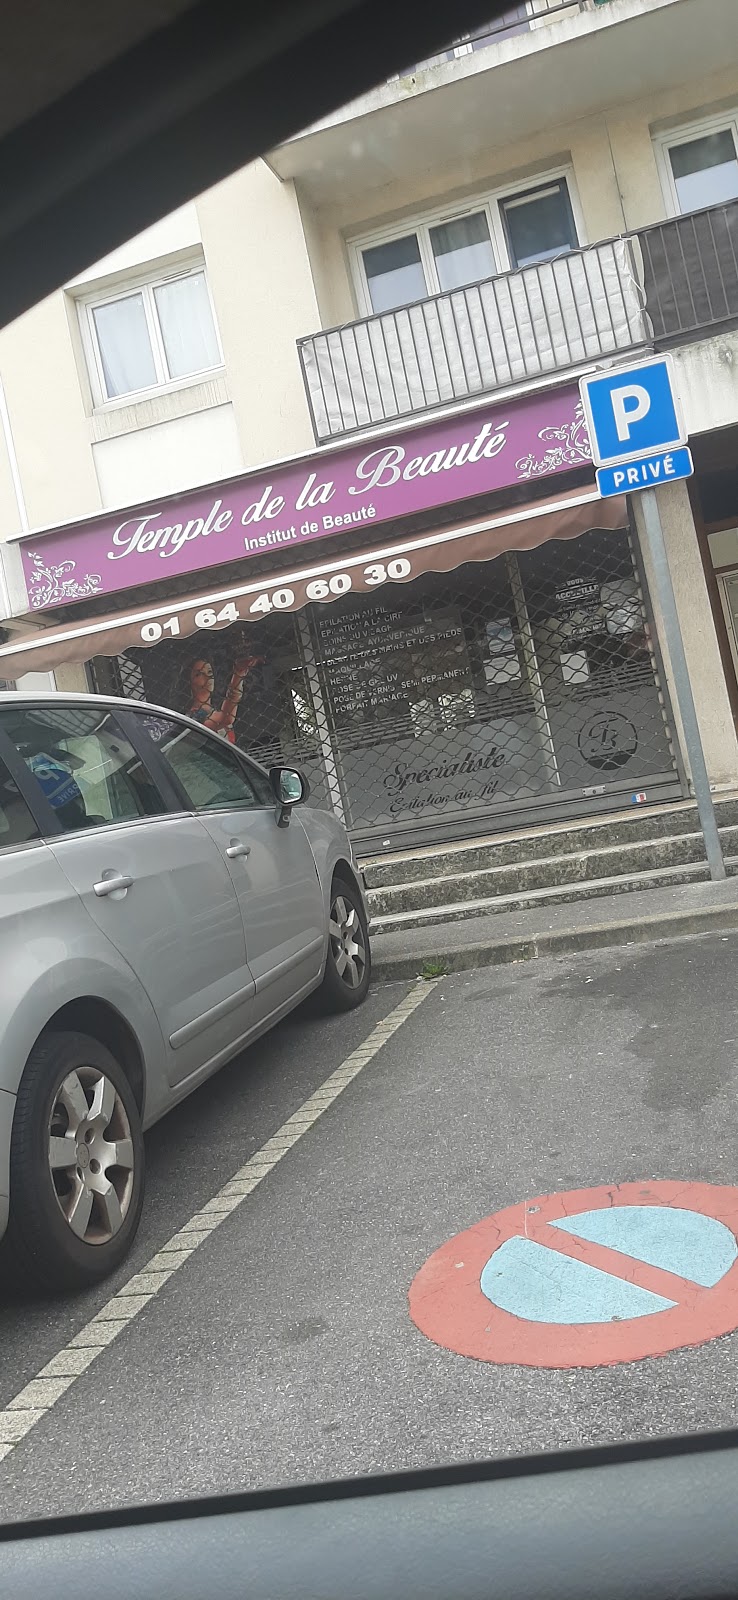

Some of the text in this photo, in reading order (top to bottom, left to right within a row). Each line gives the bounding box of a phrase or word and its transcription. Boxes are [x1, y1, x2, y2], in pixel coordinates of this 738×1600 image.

[610, 384, 651, 442] P
[107, 421, 510, 560] Temple de la Beauté
[613, 455, 676, 488] PRIVÉ
[244, 503, 377, 551] Institut de Beauté
[140, 558, 412, 642] 01 64 40 60 30
[320, 621, 363, 638] EPIATIO
[362, 624, 393, 638] VSAGE
[386, 673, 399, 682] UV
